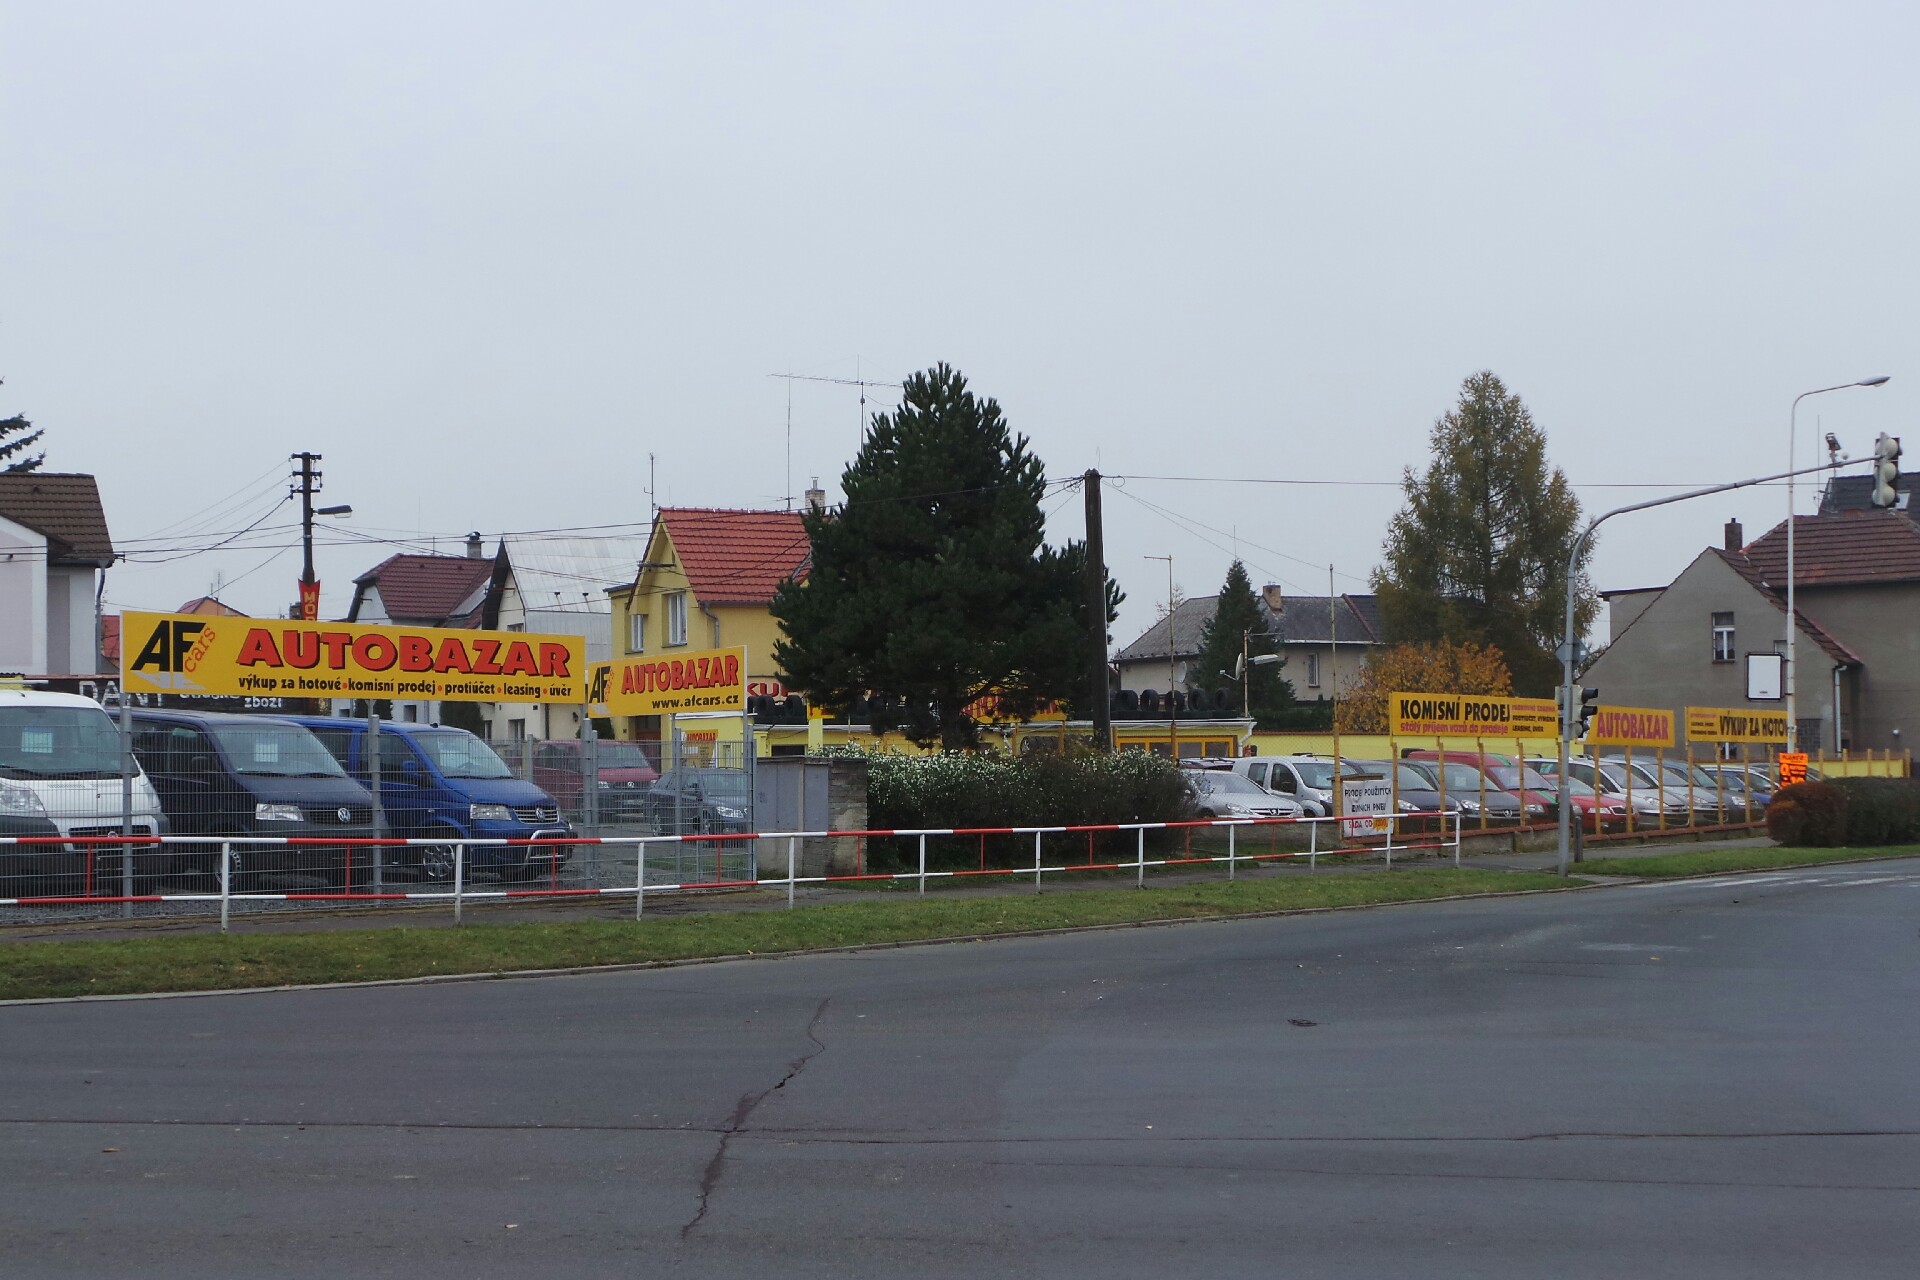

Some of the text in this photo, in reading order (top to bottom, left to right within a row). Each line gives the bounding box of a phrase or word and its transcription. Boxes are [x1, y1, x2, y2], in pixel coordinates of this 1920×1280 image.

[130, 620, 207, 672] AF
[184, 626, 216, 673] cars
[236, 628, 570, 677] AUTOBAZAR
[238, 675, 572, 698] výkup za hotové komisní prodej protiúčet leasing úvěr
[588, 665, 611, 703] AF
[620, 655, 739, 694] AUTOBAZAR
[651, 694, 740, 709] www.afcars.cz
[1400, 697, 1511, 722] KOMISNÍ PRODEJ
[1470, 724, 1479, 733] do
[1597, 713, 1669, 740] AUTOBAZAR
[1720, 710, 1746, 736] VÝKUP
[1749, 717, 1760, 736] ZA
